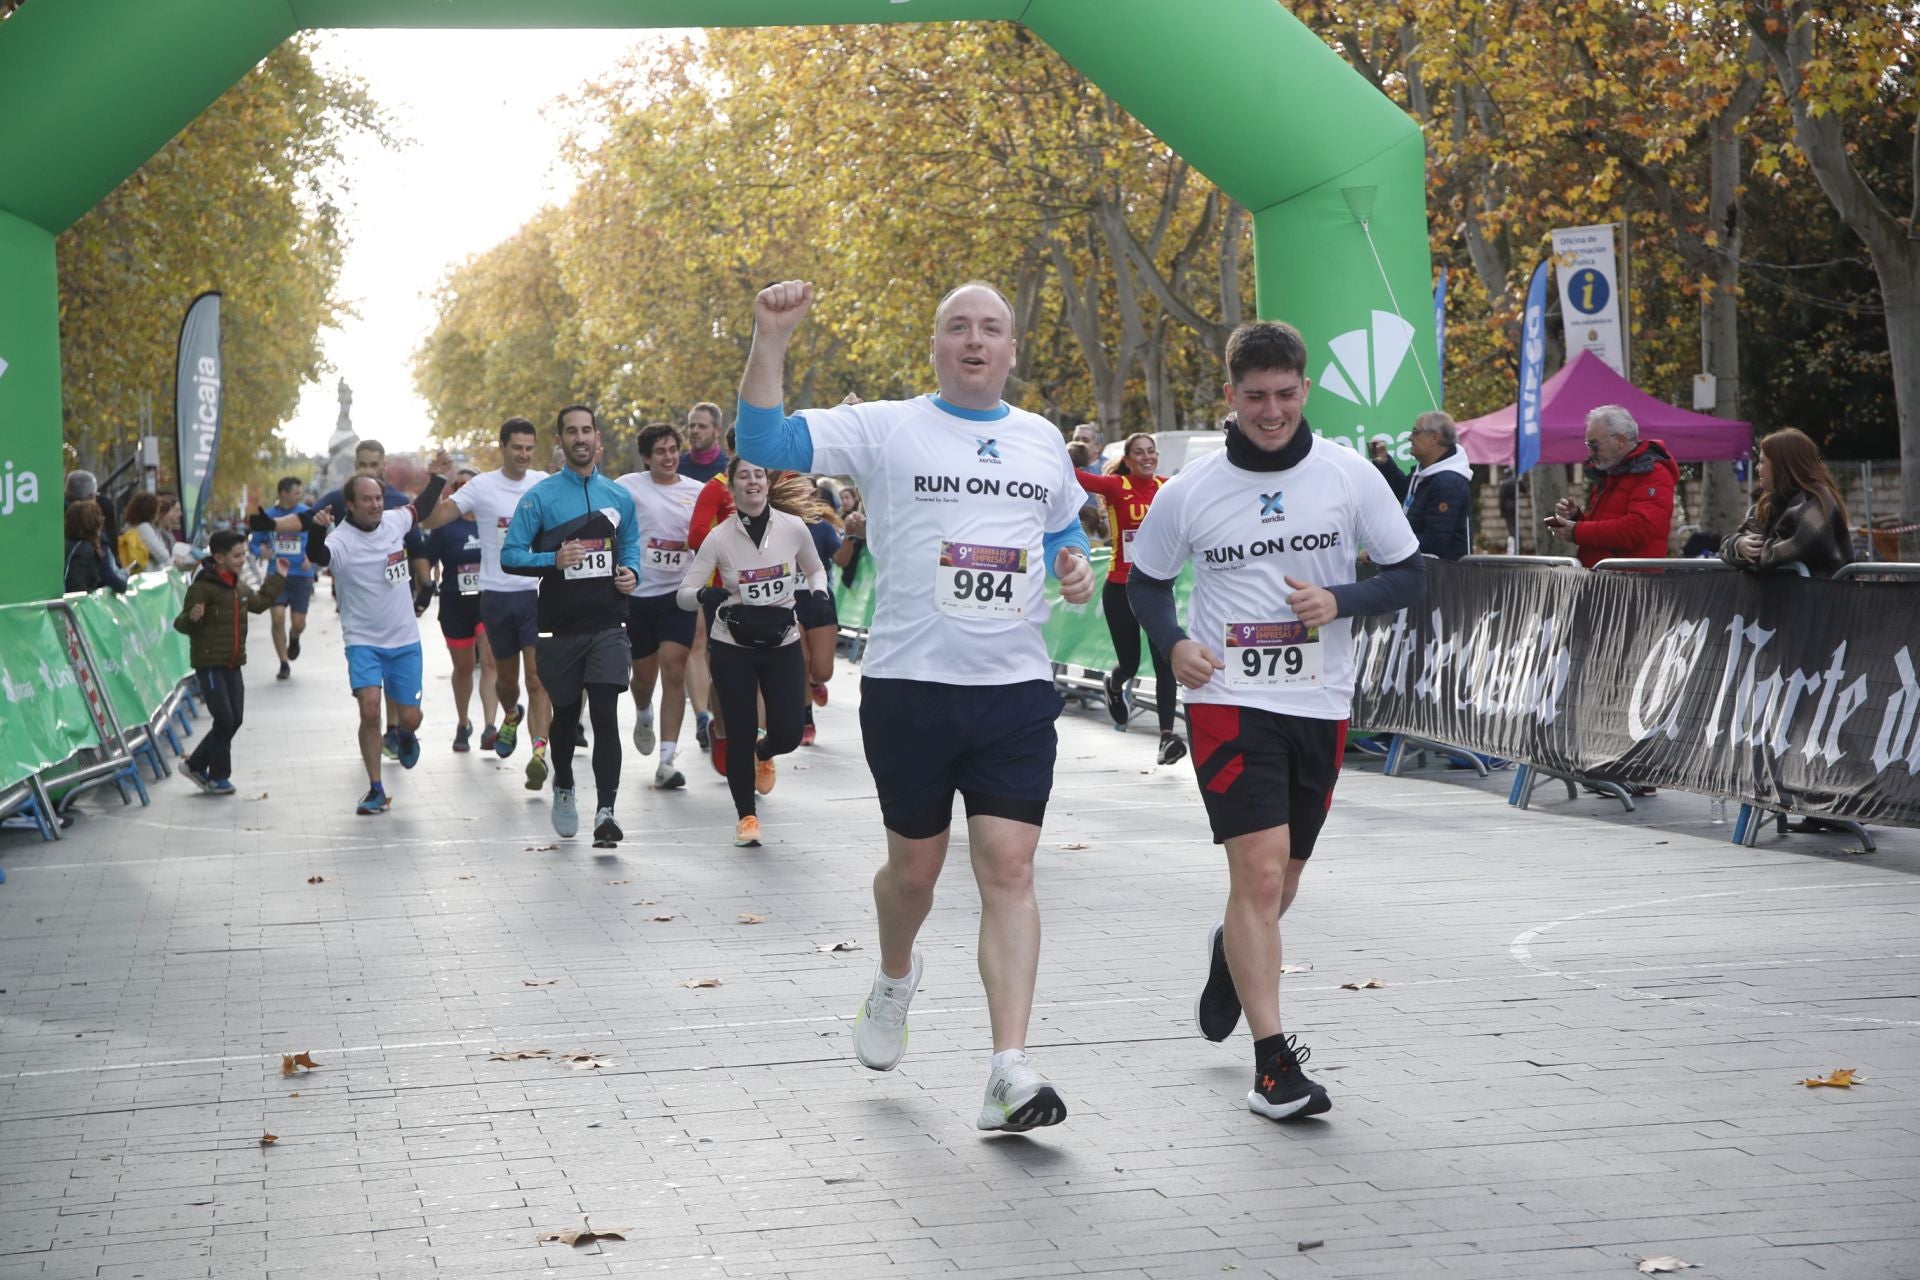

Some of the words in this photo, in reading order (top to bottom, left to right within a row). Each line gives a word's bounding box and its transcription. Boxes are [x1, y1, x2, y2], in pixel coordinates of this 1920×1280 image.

[0, 460, 39, 516] ja
[914, 475, 960, 493] RUN
[966, 477, 1000, 496] ON
[1261, 515, 1285, 524] xeridia
[652, 551, 681, 566] 314
[1203, 544, 1245, 563] RUN
[1250, 537, 1285, 557] ON
[386, 562, 406, 581] 313
[747, 580, 784, 599] 519
[953, 569, 1013, 604] 984
[1255, 630, 1292, 639] EMPRESAS
[1241, 646, 1304, 678] 979
[1704, 614, 1868, 768] Norte
